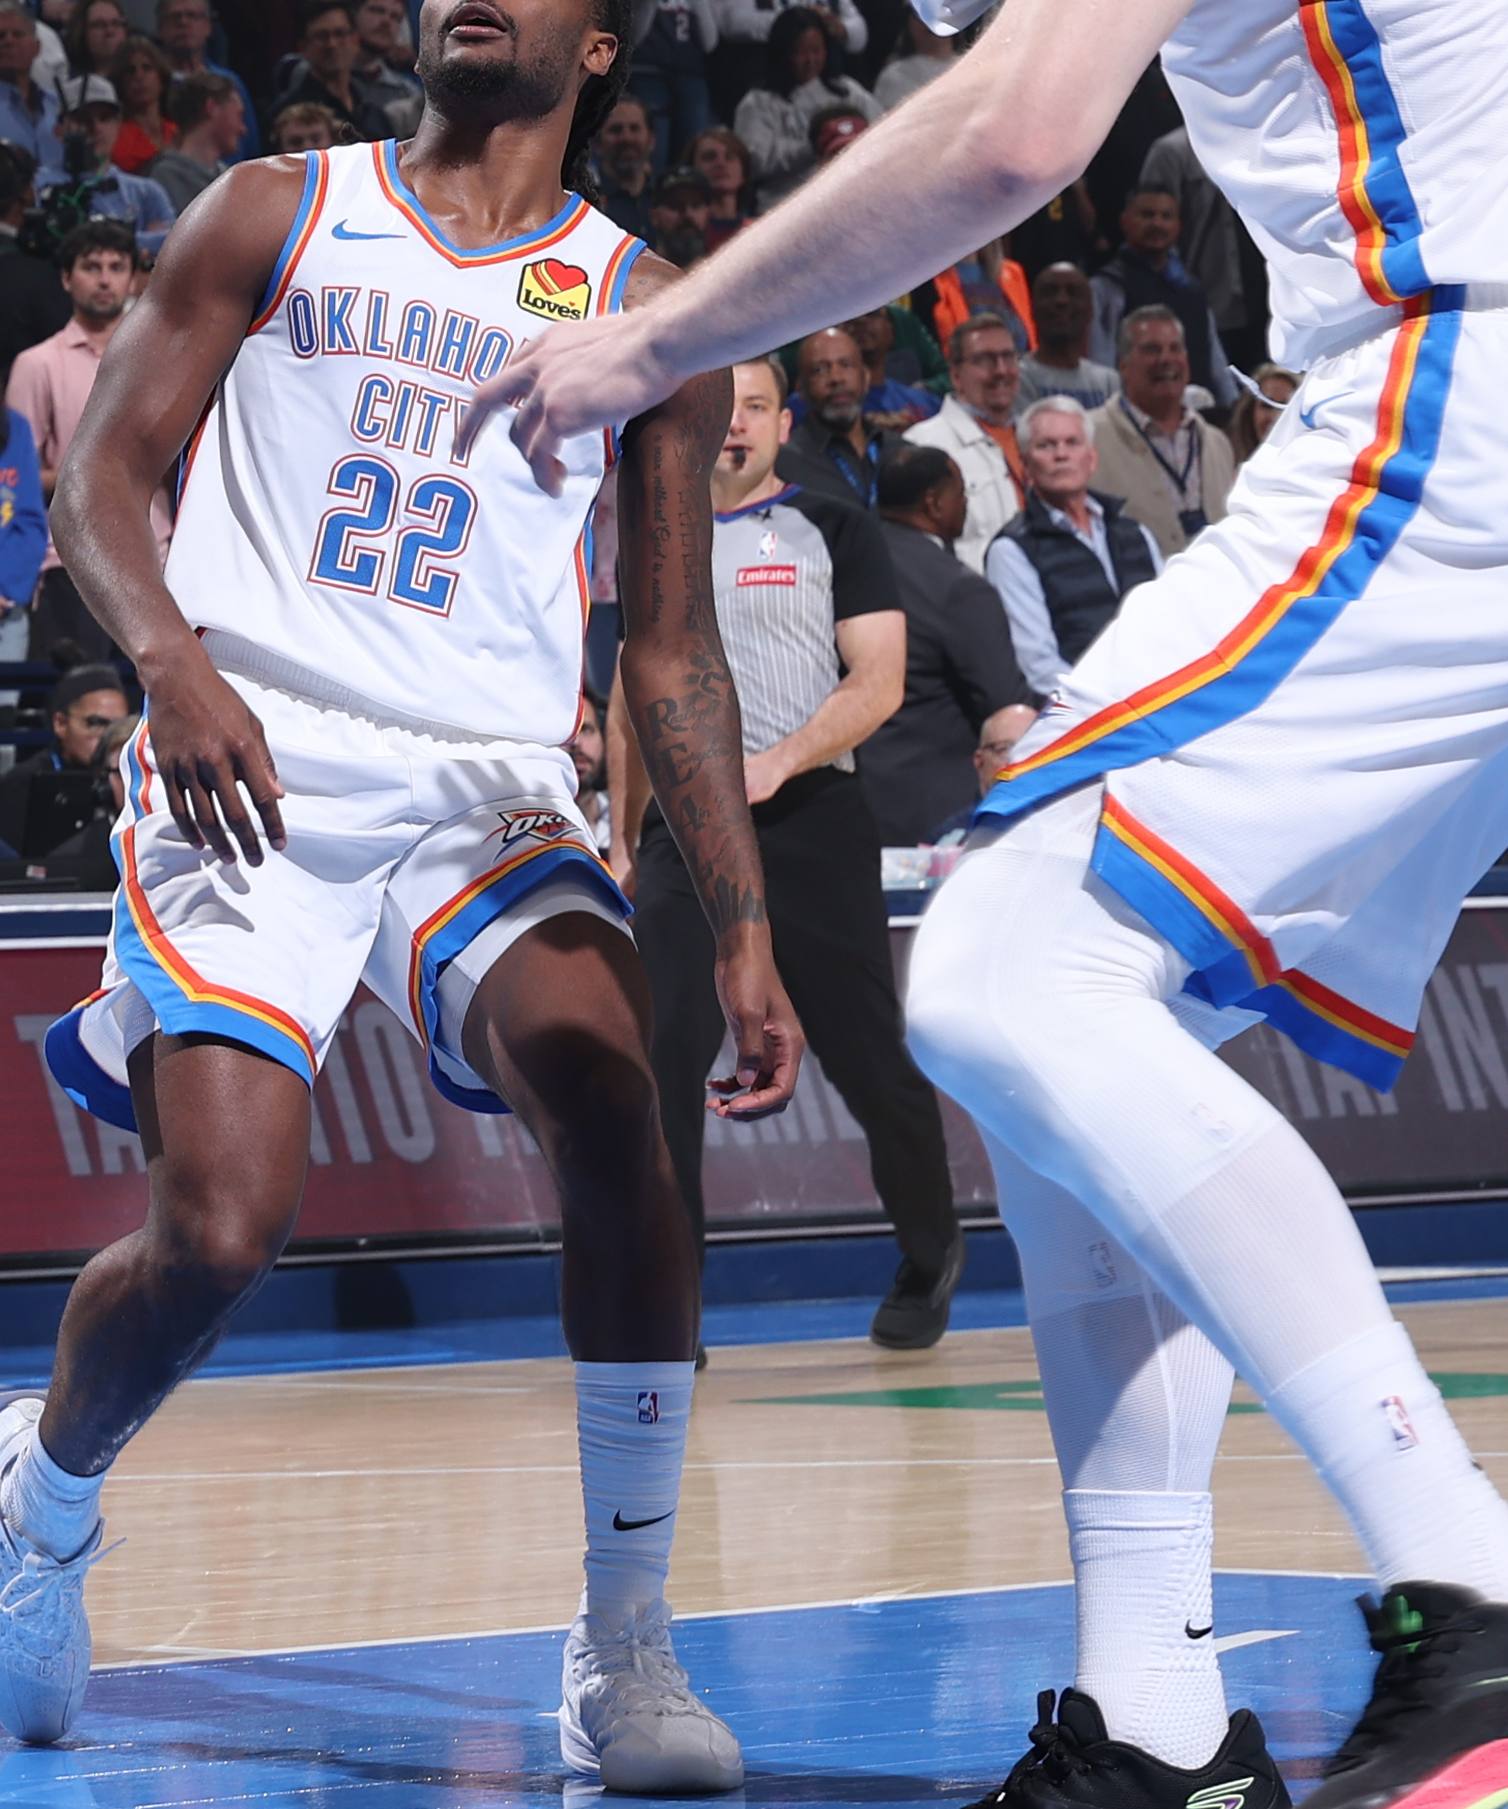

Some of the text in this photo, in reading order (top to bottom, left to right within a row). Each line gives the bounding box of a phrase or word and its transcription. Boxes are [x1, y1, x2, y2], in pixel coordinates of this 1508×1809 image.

[287, 286, 519, 396] OKLAHO
[307, 453, 478, 619] 22
[738, 569, 796, 585] Emirates
